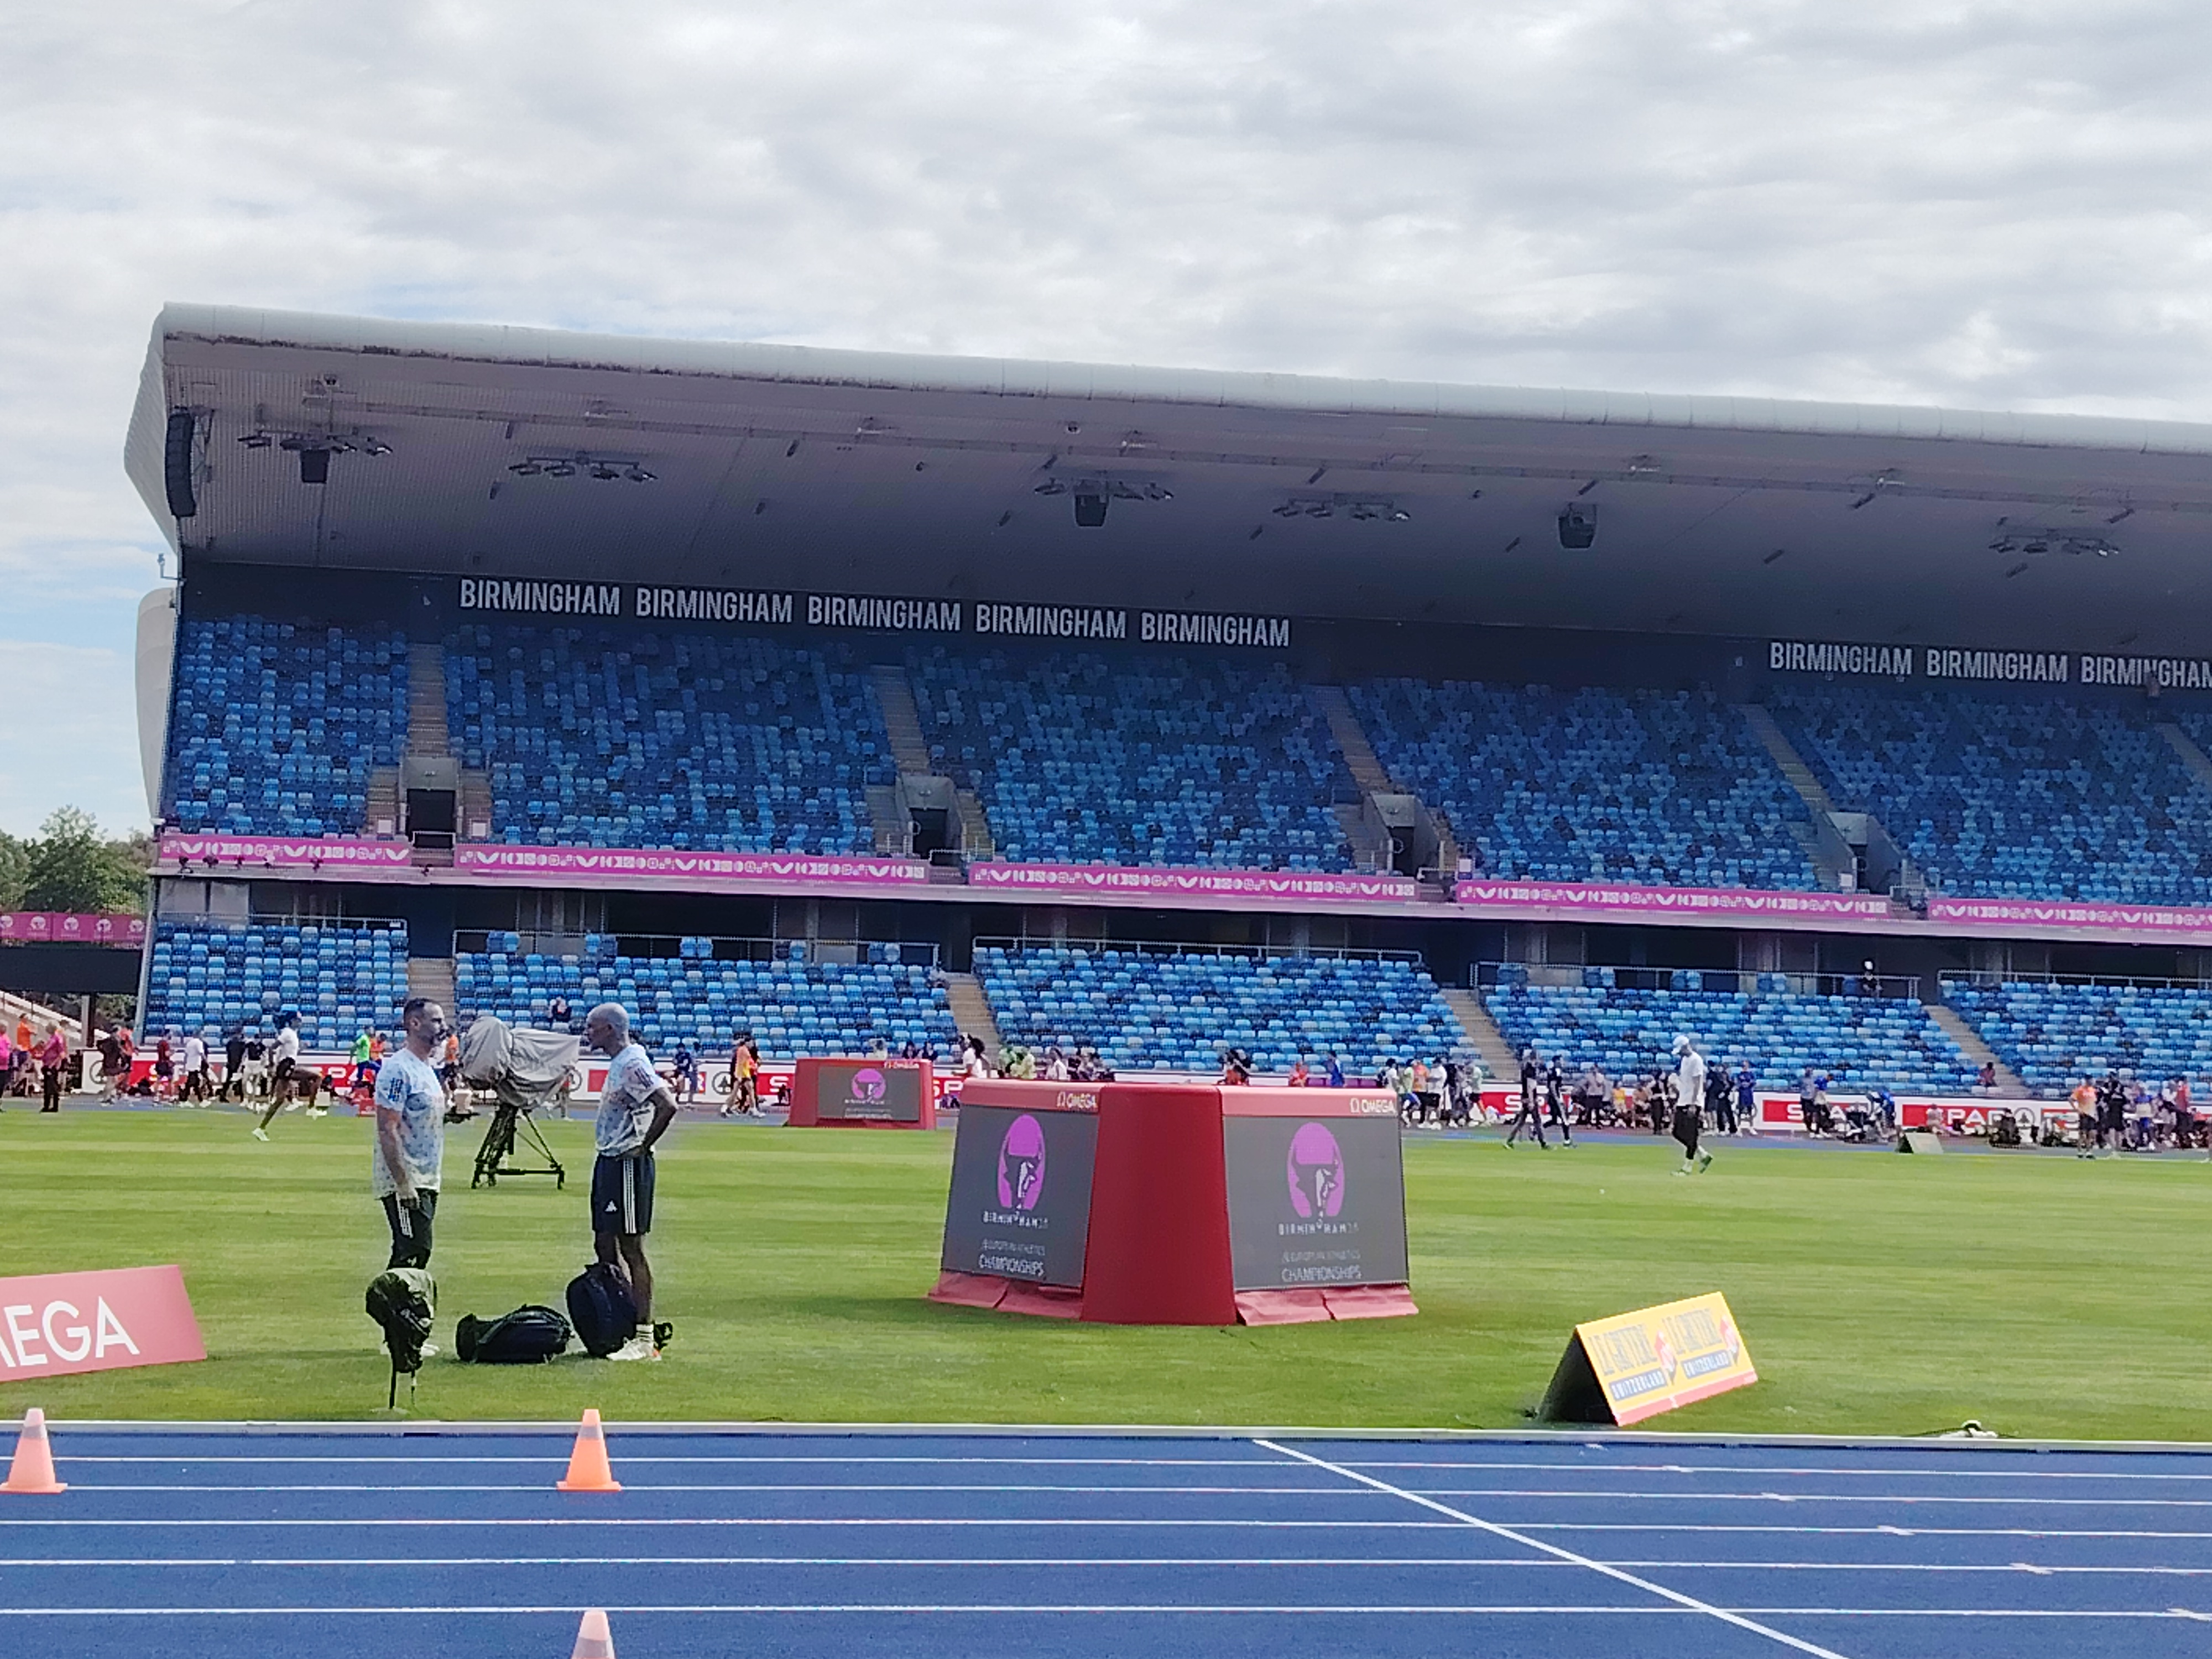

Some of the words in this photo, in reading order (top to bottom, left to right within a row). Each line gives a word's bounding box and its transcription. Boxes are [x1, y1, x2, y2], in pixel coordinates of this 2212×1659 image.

[460, 579, 620, 615] BIRMINGHAM
[636, 587, 792, 623] BIRMINGHAM
[807, 596, 961, 632] BIRMINGHAM
[975, 604, 1126, 639] BIRMINGHAM
[1141, 612, 1290, 647] BIRMINGHAM
[1770, 641, 1912, 675] BIRMINGHAM
[1926, 649, 2068, 682] BIRMINGHAM
[1067, 1093, 1098, 1109] OMEGA
[1361, 1099, 1398, 1114] OMEGA
